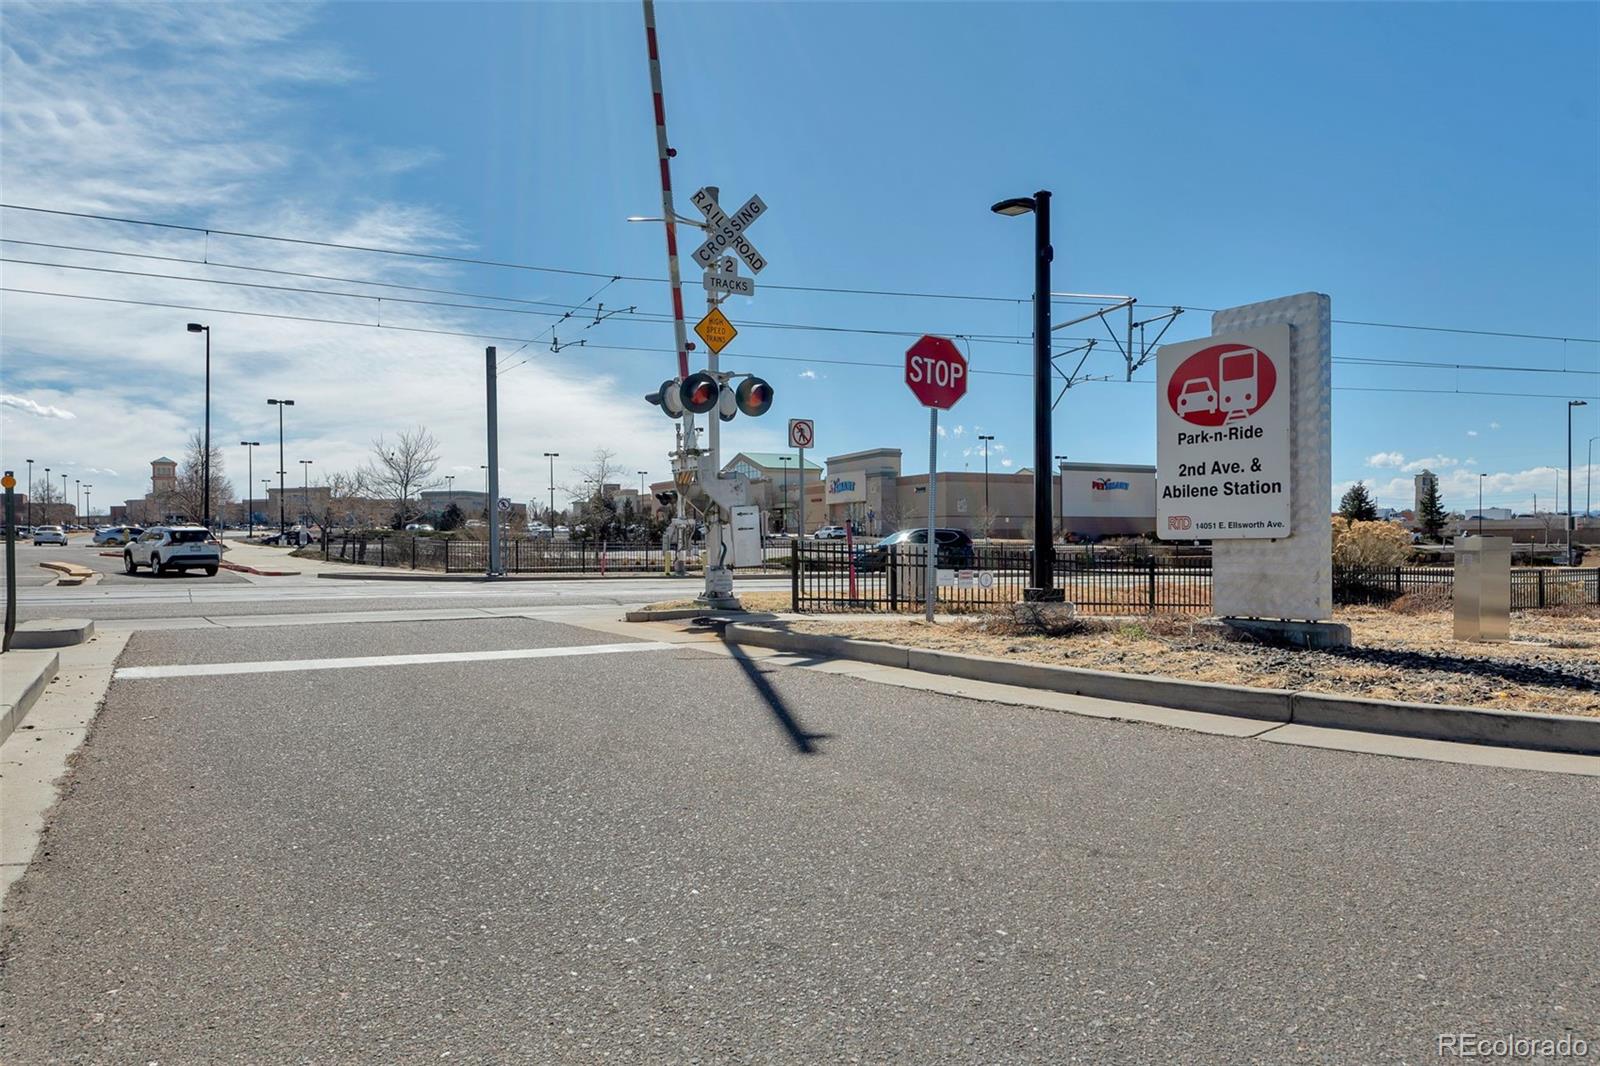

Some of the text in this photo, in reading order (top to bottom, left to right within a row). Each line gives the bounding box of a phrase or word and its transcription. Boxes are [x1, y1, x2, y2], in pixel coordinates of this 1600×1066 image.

[693, 190, 763, 271] RAIL ROAD
[699, 201, 760, 261] CROSSING
[725, 260, 733, 272] 2
[710, 277, 748, 291] TRACKS
[909, 355, 963, 388] STOP
[1178, 425, 1263, 445] Park-n-Ride
[1178, 457, 1262, 477] 2nd Ave. &
[1162, 480, 1282, 499] Abilene Station
[1167, 515, 1192, 530] RTD
[1195, 520, 1285, 530] 14051 E. Ellsworth Ave.
